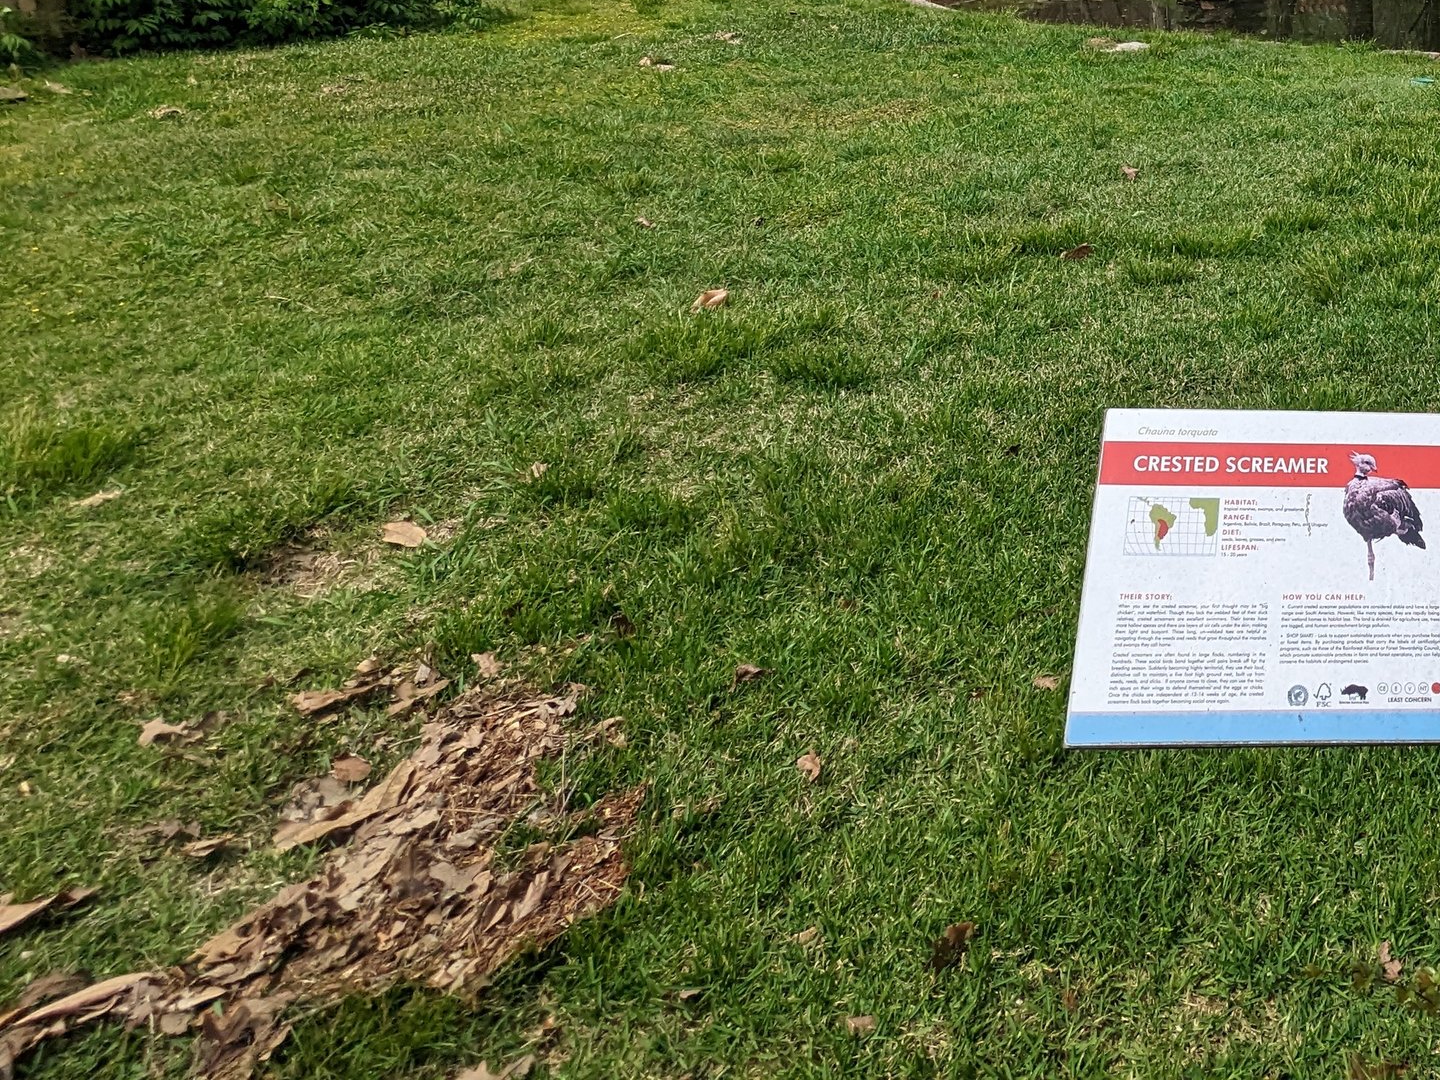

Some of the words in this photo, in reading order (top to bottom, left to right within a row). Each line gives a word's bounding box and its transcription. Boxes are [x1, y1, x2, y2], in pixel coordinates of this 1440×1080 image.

[1138, 426, 1175, 436] Chauna
[1177, 427, 1218, 439] torquata
[1133, 456, 1218, 473] CRESTED
[1226, 456, 1328, 474] SCREAMER
